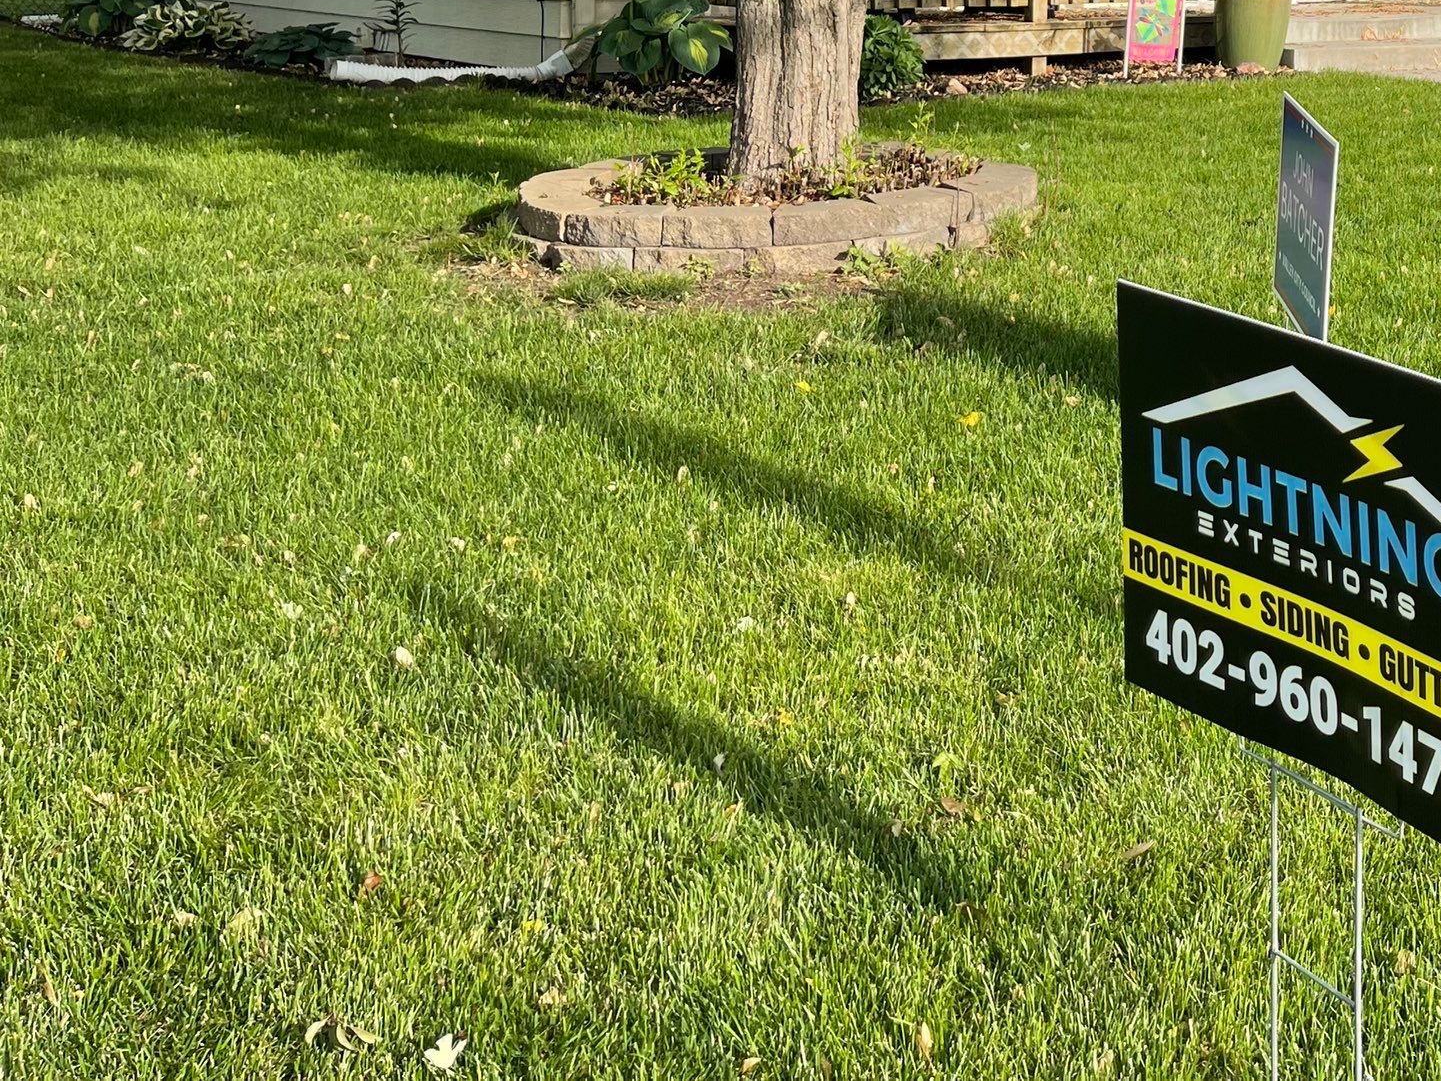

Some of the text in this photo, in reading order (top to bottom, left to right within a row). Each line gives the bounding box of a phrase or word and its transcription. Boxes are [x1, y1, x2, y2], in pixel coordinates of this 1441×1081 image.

[1293, 150, 1314, 198] JOHN
[1281, 181, 1324, 271] BATCHER
[1128, 536, 1231, 610] ROOFING
[1259, 590, 1350, 661] SIDING
[1197, 510, 1416, 621] EXTERIORS
